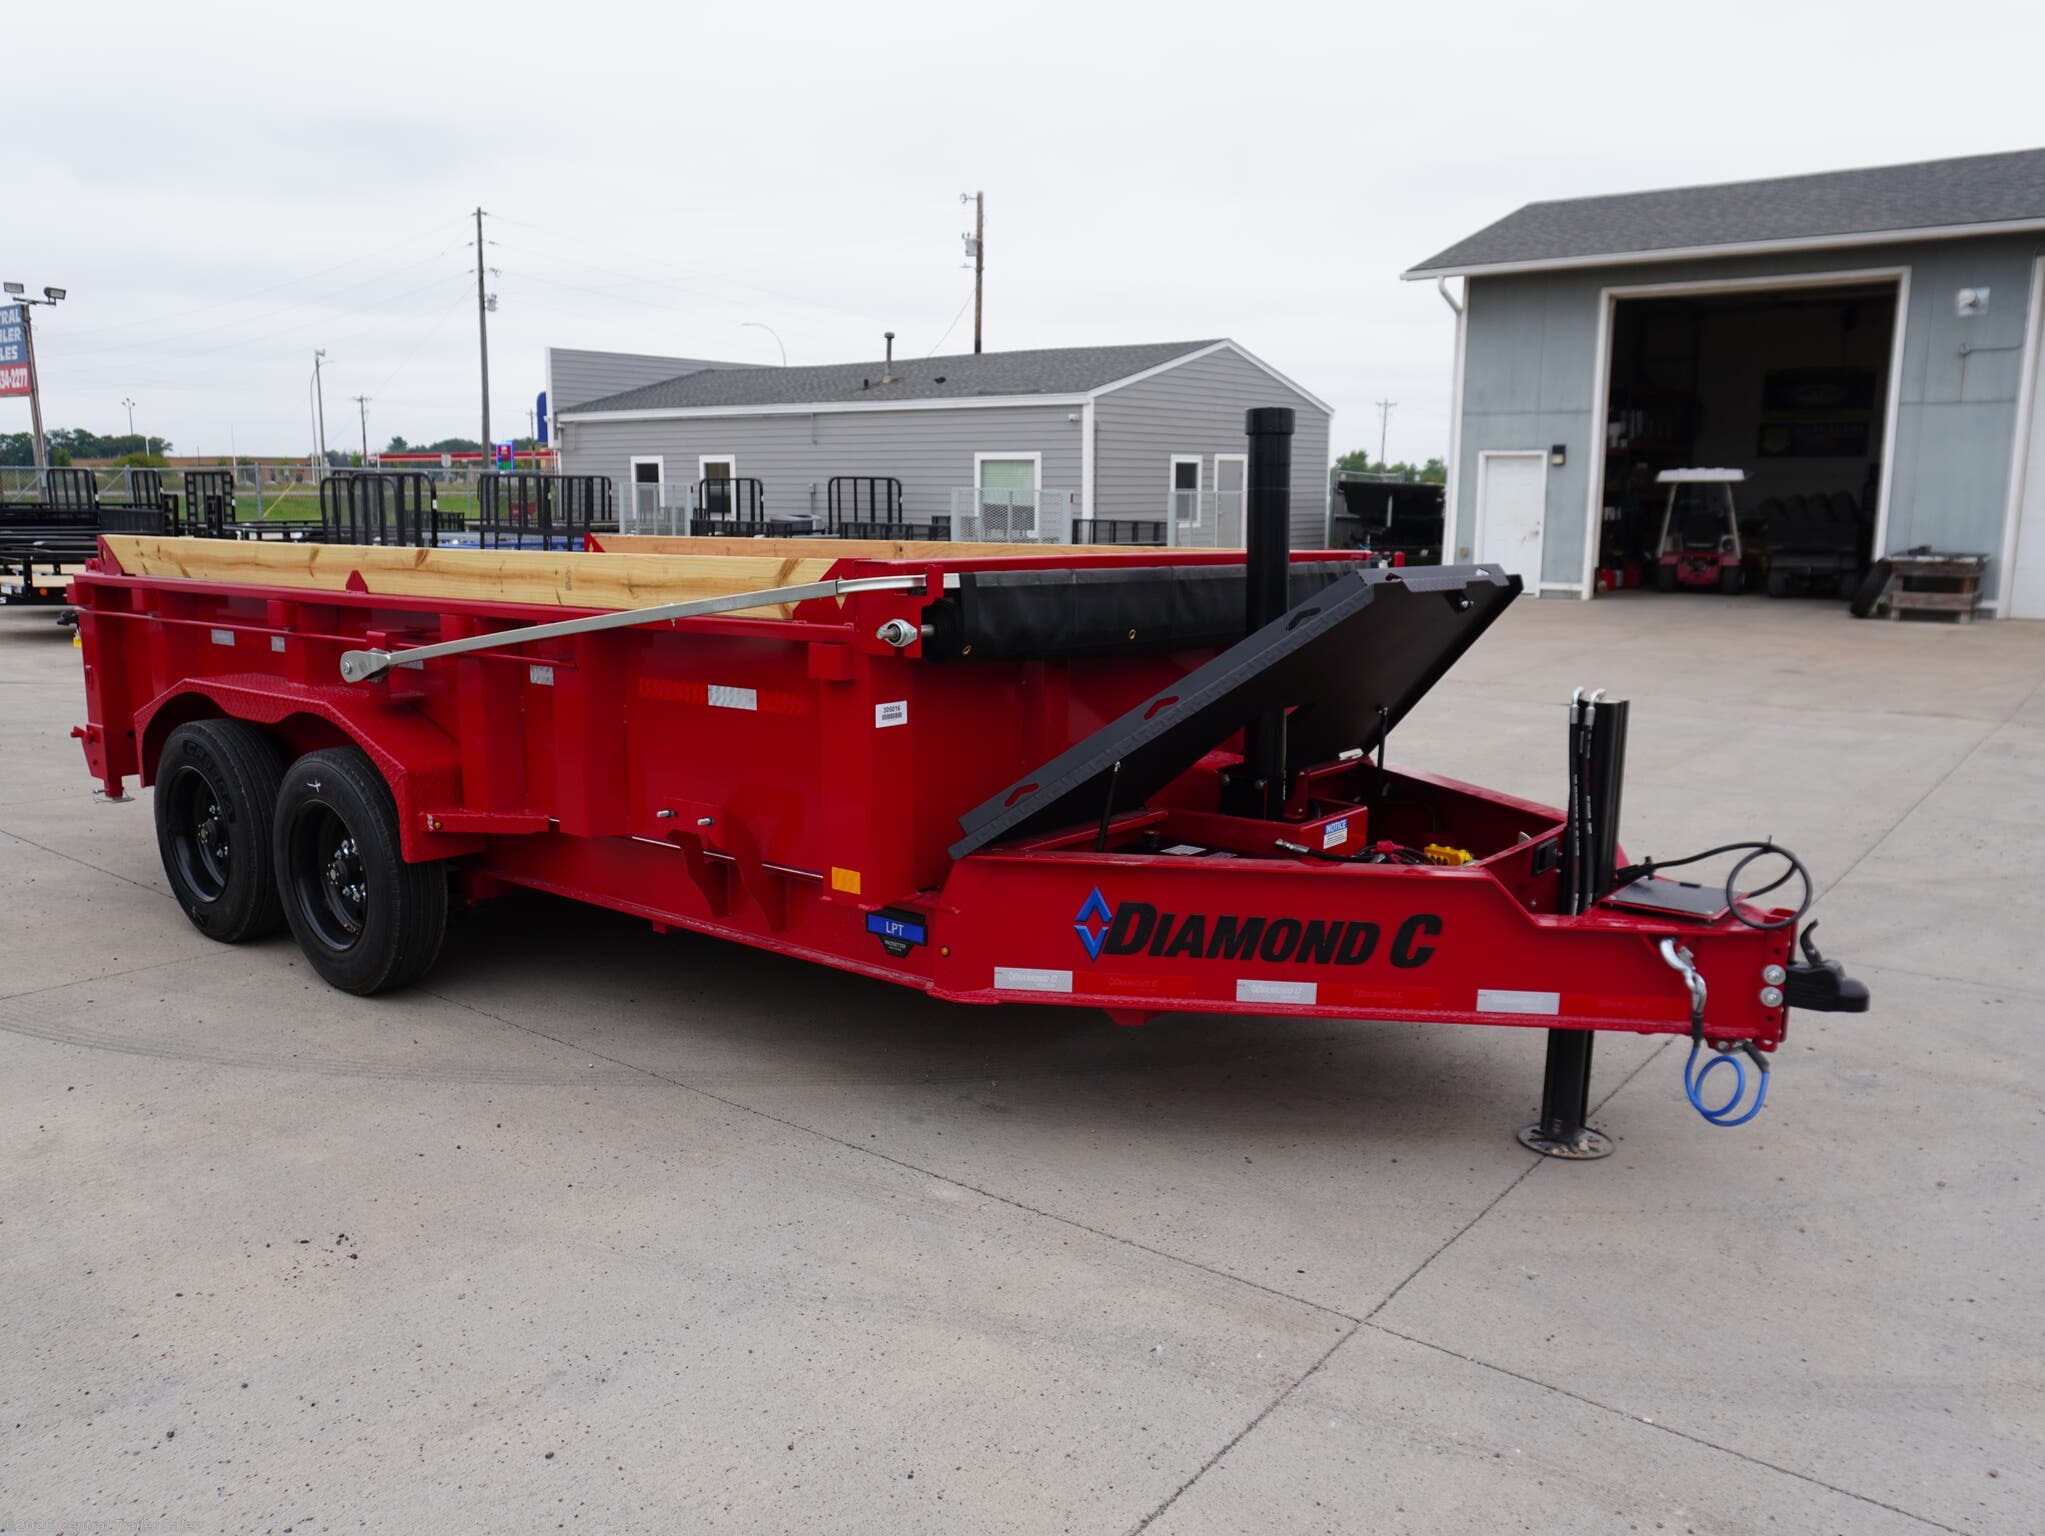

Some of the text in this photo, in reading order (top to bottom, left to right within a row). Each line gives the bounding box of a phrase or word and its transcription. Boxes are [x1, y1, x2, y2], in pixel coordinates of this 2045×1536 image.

[1326, 818, 1347, 834] NOTICE
[886, 921, 904, 937] LPT
[1102, 900, 1443, 968] DIAMOND C
